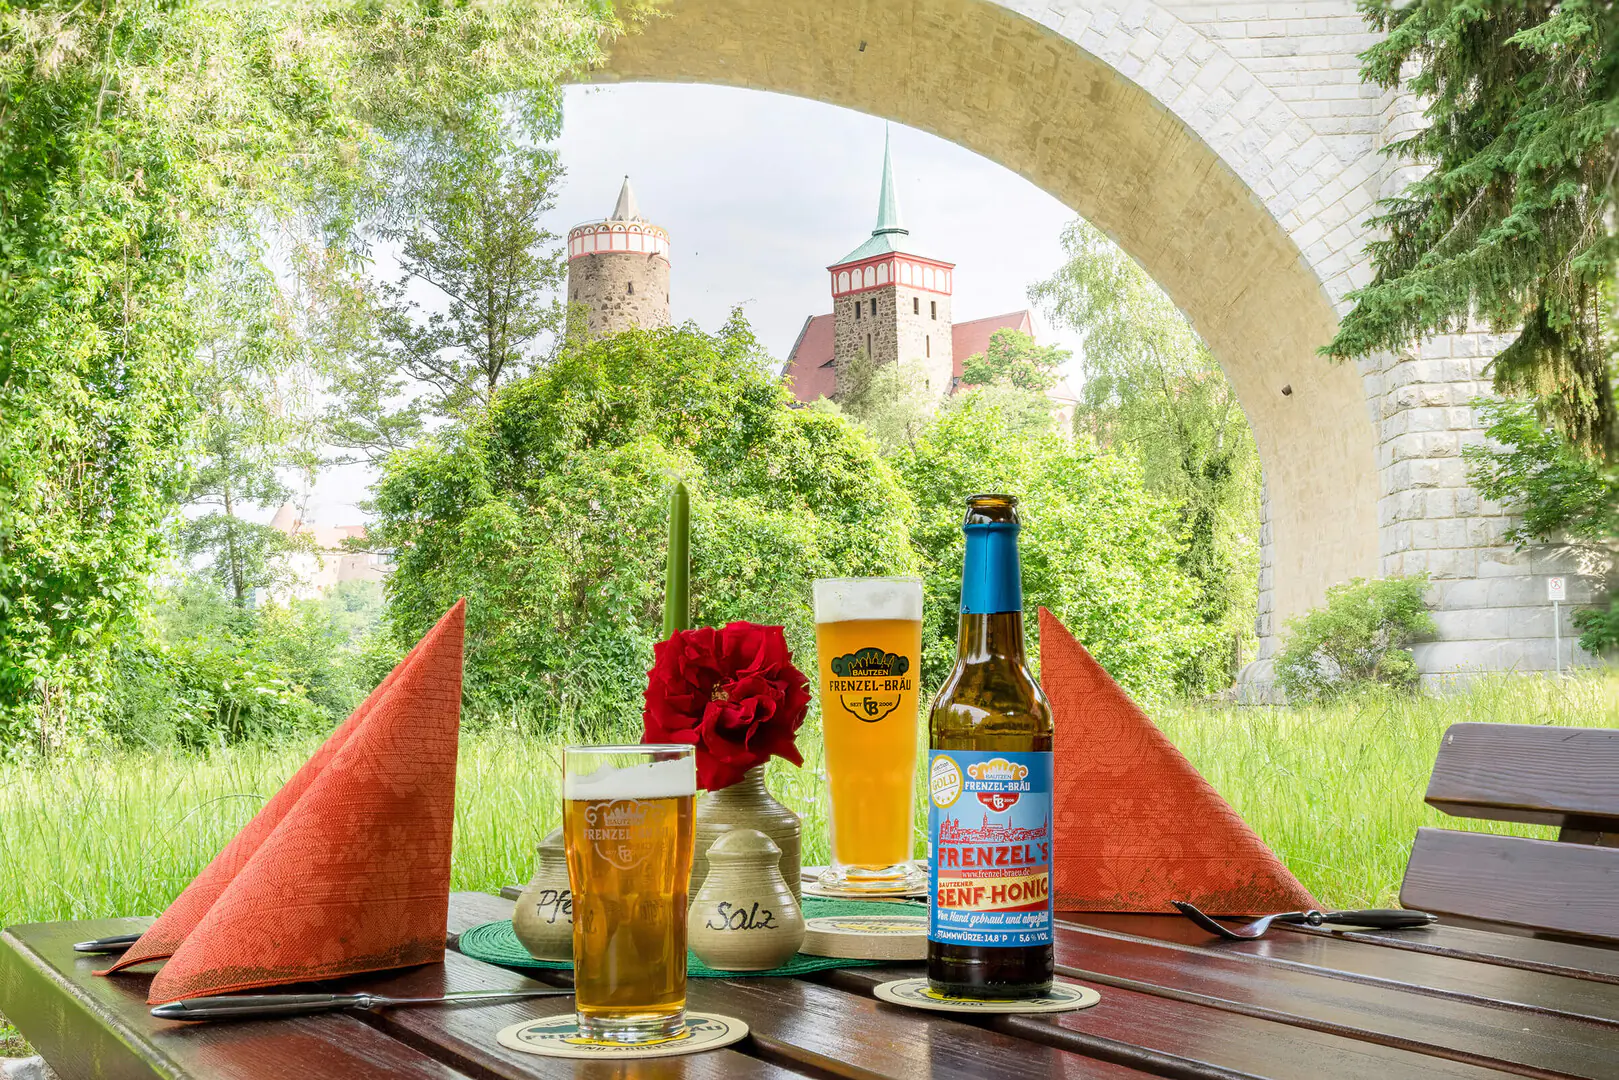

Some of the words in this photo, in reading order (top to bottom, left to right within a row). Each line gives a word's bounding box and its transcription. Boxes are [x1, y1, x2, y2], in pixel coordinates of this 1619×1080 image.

[829, 677, 911, 691] FRENZEL-BRÄU
[932, 773, 957, 791] GOLD
[965, 780, 1031, 791] FRENZEL-BRÄU
[962, 867, 1031, 878] www.frenzel-braeu.de
[706, 902, 779, 931] Salz
[949, 911, 970, 923] Hand
[968, 912, 1005, 928] gebraut
[1005, 913, 1022, 924] und
